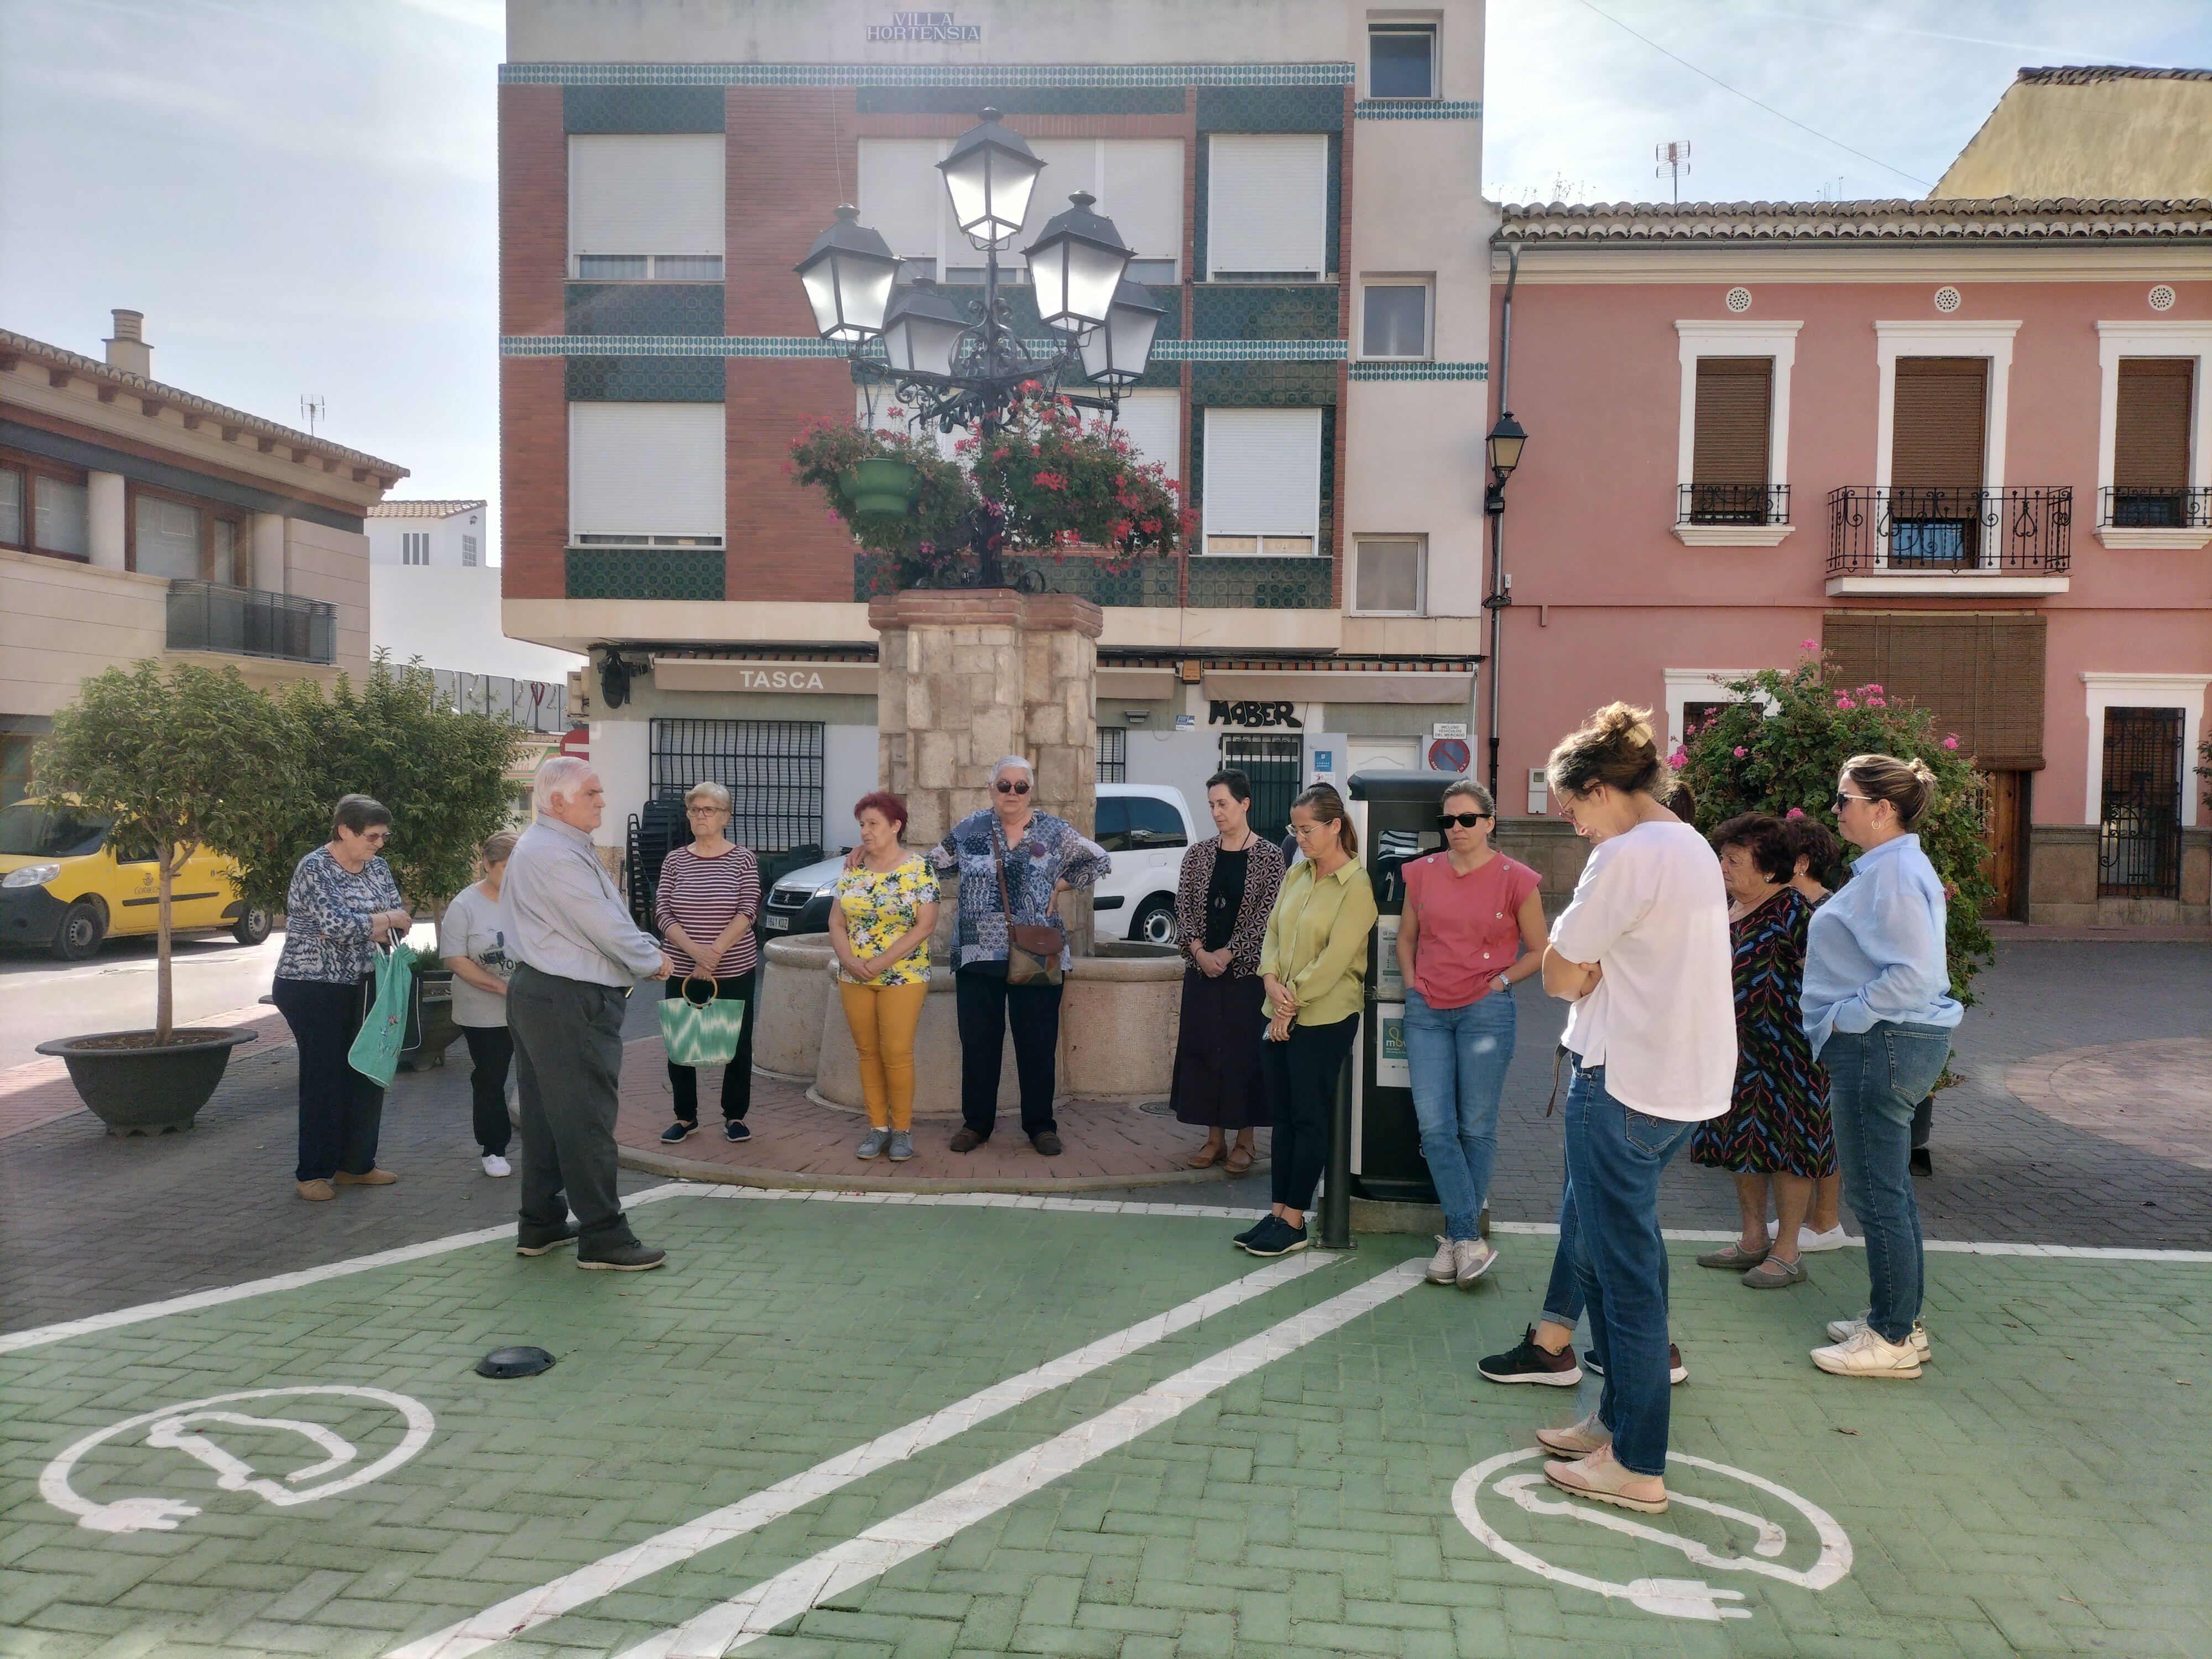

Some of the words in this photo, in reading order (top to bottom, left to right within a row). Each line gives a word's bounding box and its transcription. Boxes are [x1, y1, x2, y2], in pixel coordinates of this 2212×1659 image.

[894, 13, 953, 26] VILLA
[867, 27, 980, 40] HORTENSIA
[739, 670, 824, 690] TASCA
[134, 886, 160, 895] CORREO
